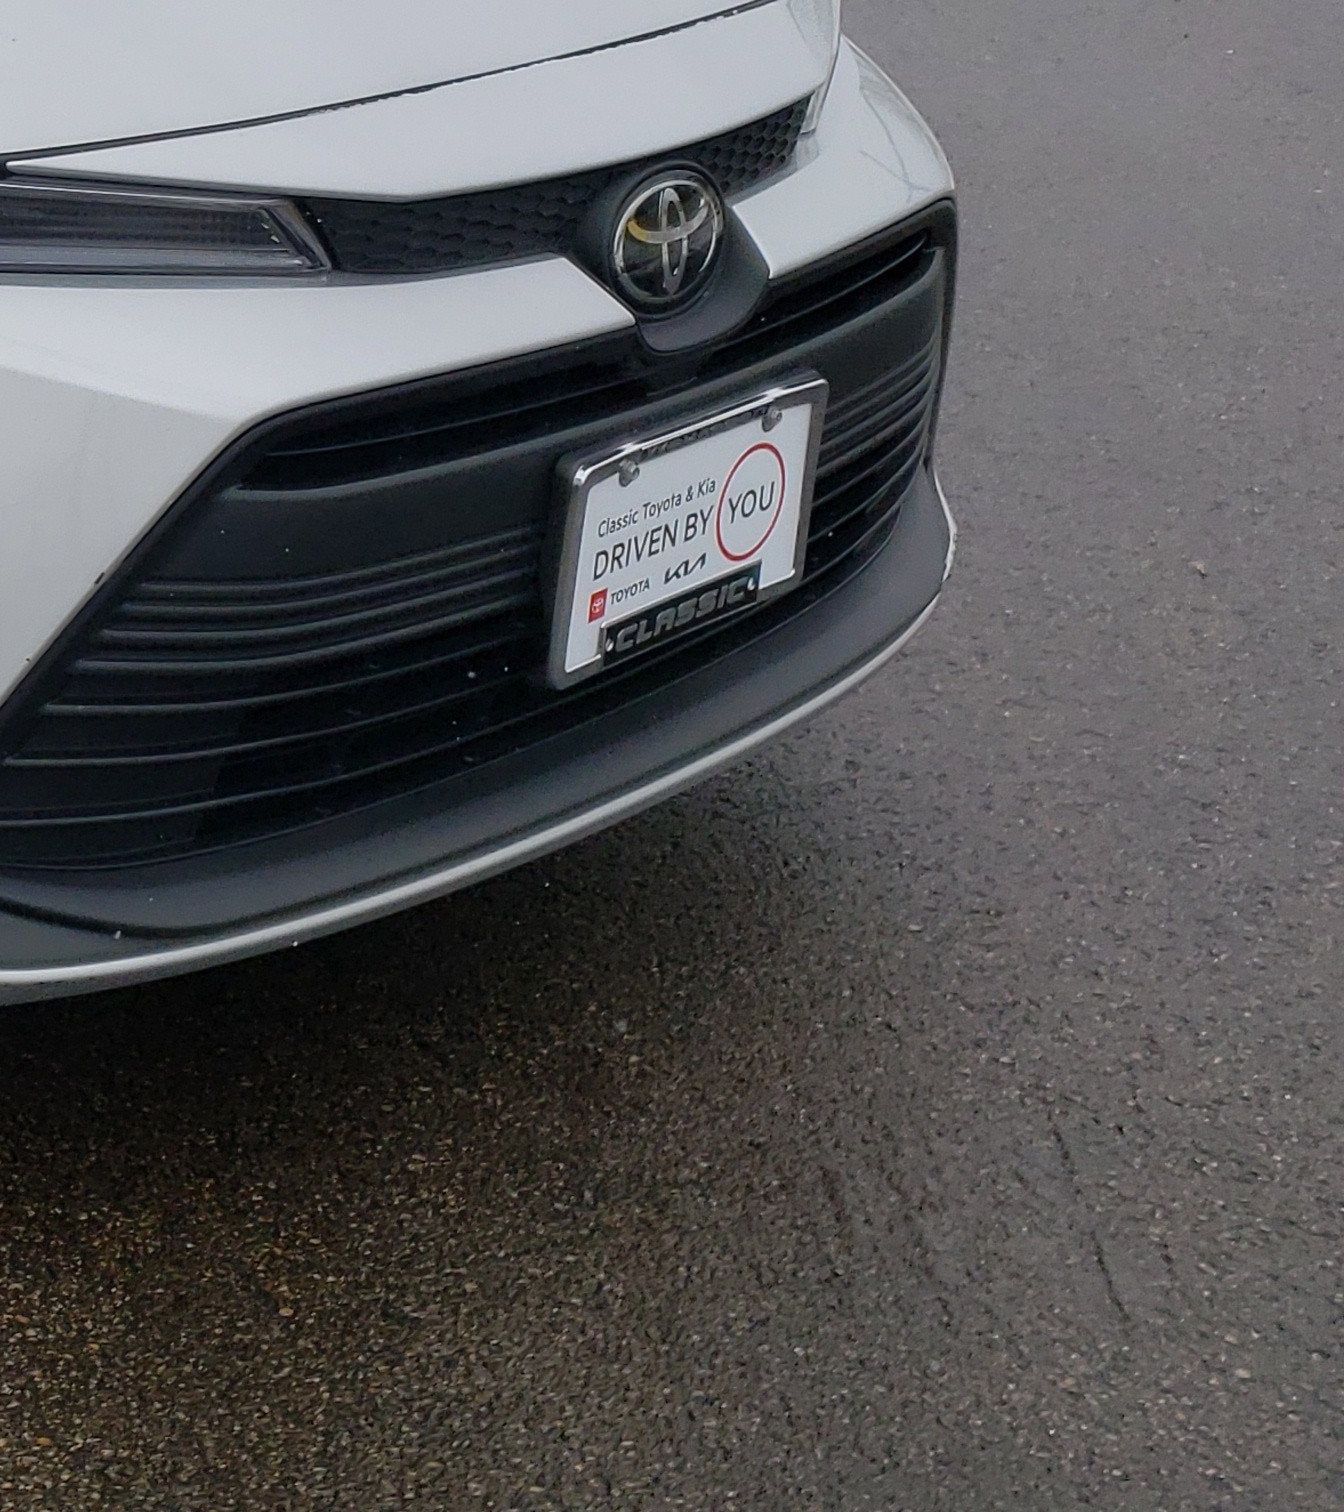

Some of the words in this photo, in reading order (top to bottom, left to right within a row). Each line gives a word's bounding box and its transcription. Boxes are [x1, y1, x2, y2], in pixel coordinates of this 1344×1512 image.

[593, 518, 679, 581] DRIVEN
[683, 504, 715, 543] BY
[728, 481, 775, 524] YOU
[598, 508, 639, 538] Classic
[642, 493, 682, 520] Toyota
[685, 485, 694, 502] &
[697, 477, 716, 499] Kia
[611, 577, 650, 605] TOYOTA
[615, 575, 751, 652] CLASSIC
